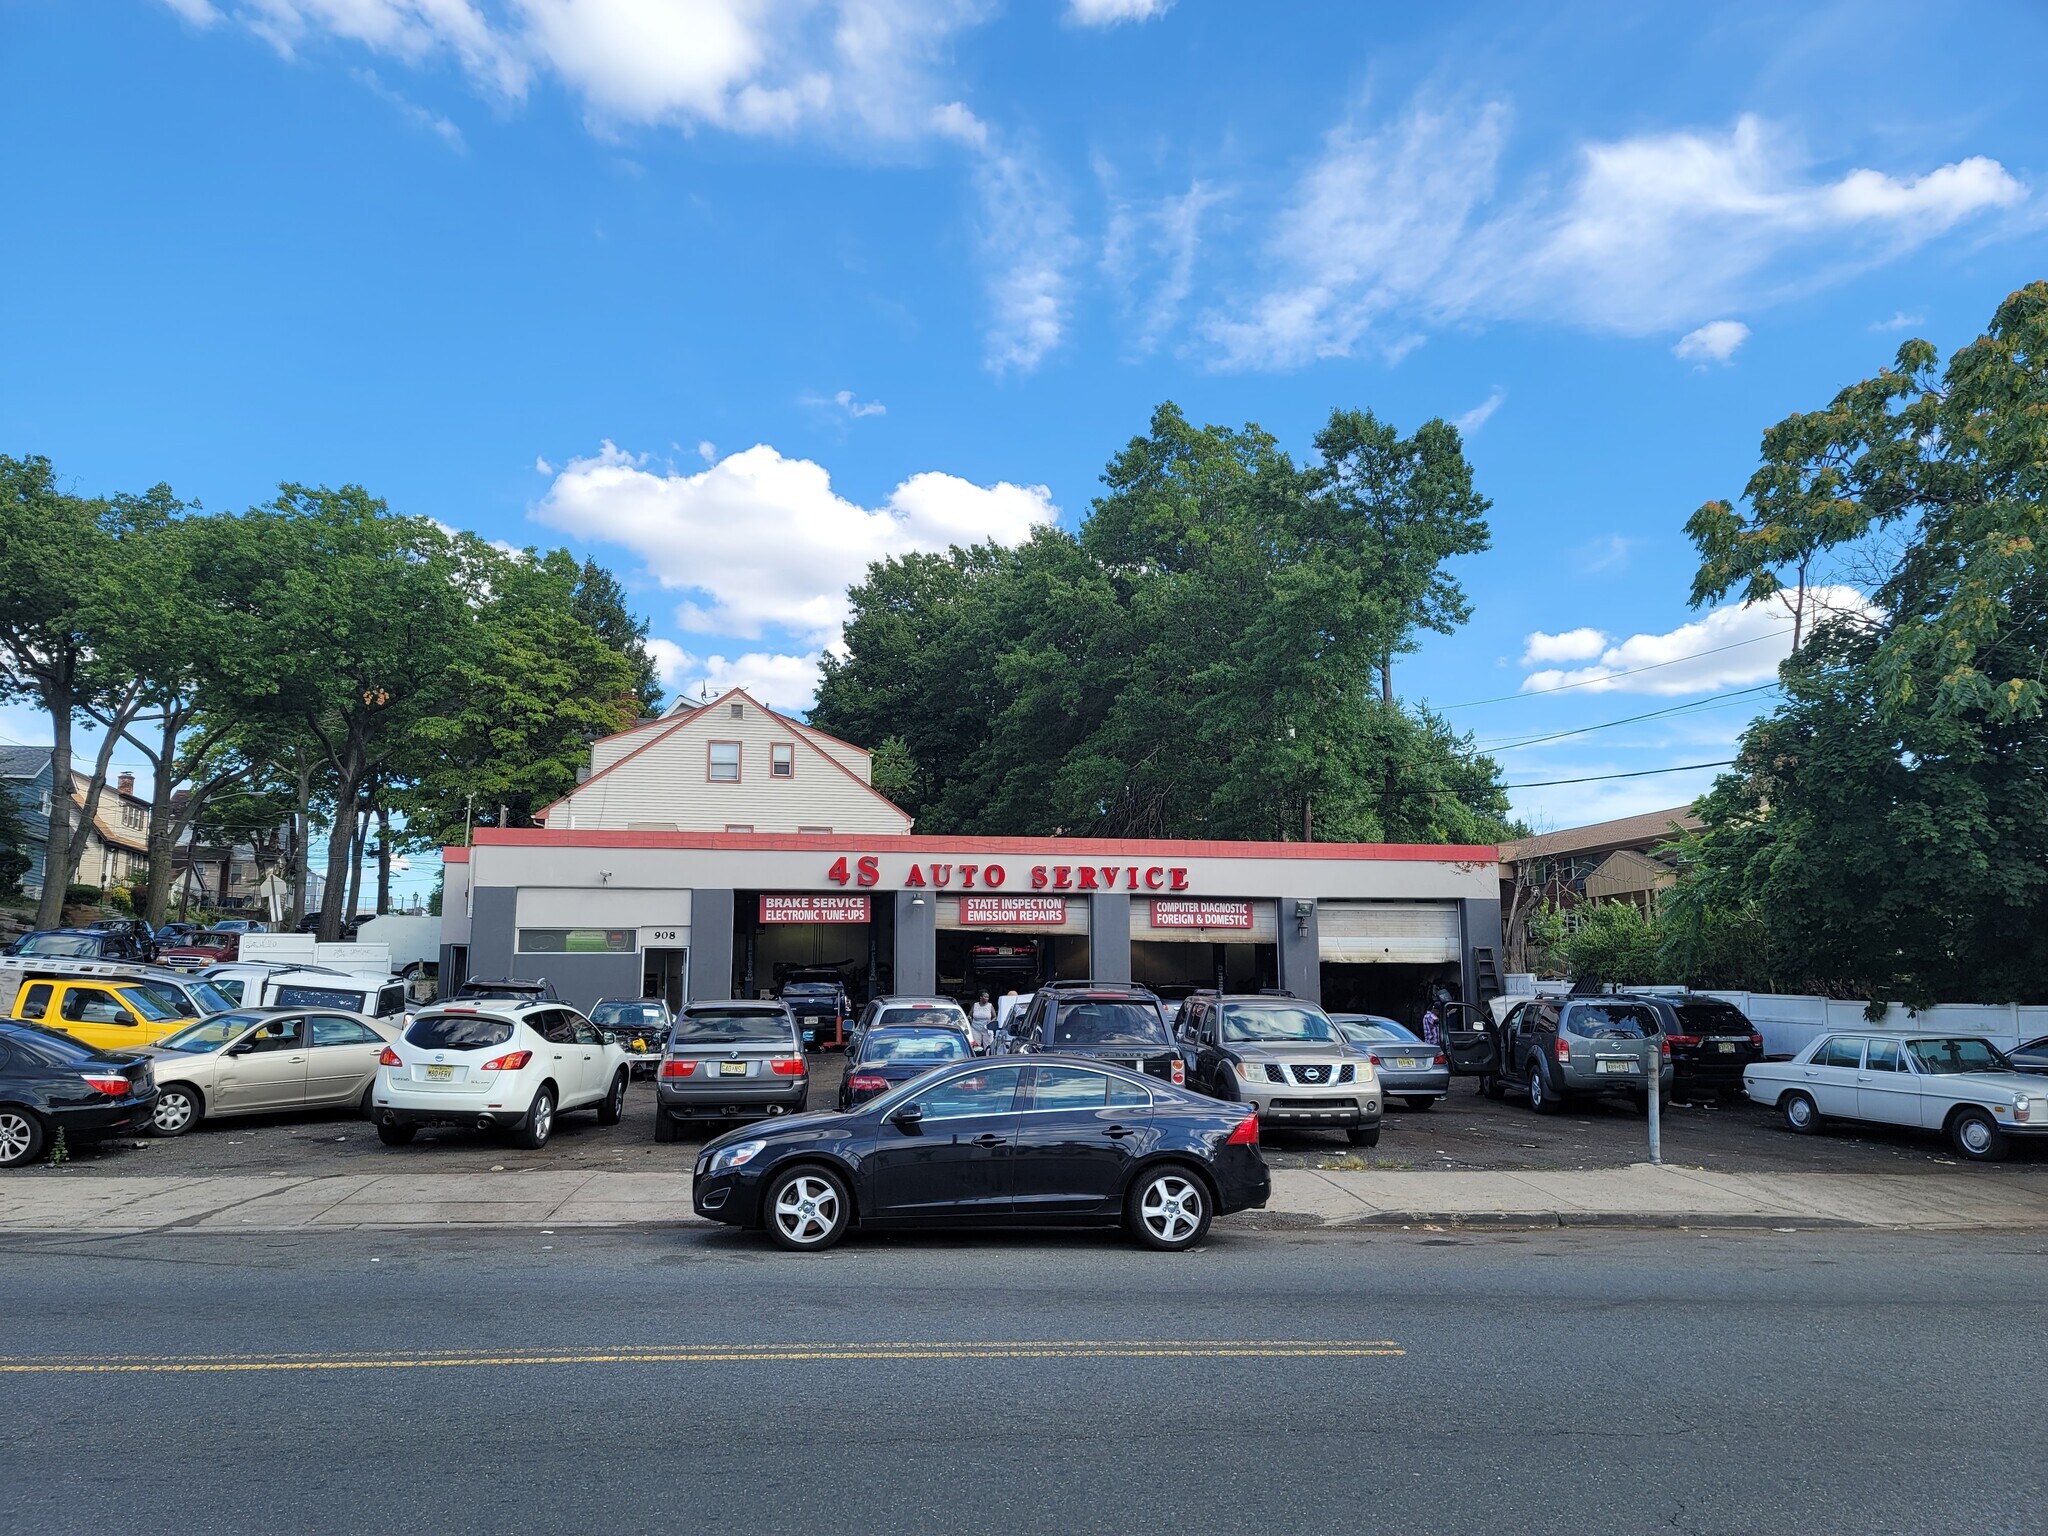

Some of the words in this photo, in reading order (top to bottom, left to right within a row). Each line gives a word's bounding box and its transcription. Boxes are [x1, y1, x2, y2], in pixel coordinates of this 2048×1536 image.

[829, 856, 880, 886] 4S
[905, 864, 1006, 888] AUTO
[1031, 866, 1189, 890] SERVICE
[766, 898, 809, 908] BRAKE
[812, 898, 864, 908] SERVICE
[967, 899, 999, 909] STATE
[1001, 899, 1062, 909] INSPECTION
[1157, 902, 1199, 912] COMPUTER
[1200, 903, 1248, 914] DIAGNOSTIC
[766, 910, 819, 920] ELECTRONIC
[821, 910, 865, 920] TUNE-UPS
[967, 910, 1017, 921] EMISSION
[1019, 910, 1063, 920] REPAIRS
[1157, 914, 1194, 924] FOREIGN
[1196, 915, 1203, 924] &
[1205, 915, 1248, 925] DOMESTIC
[654, 931, 676, 940] 908
